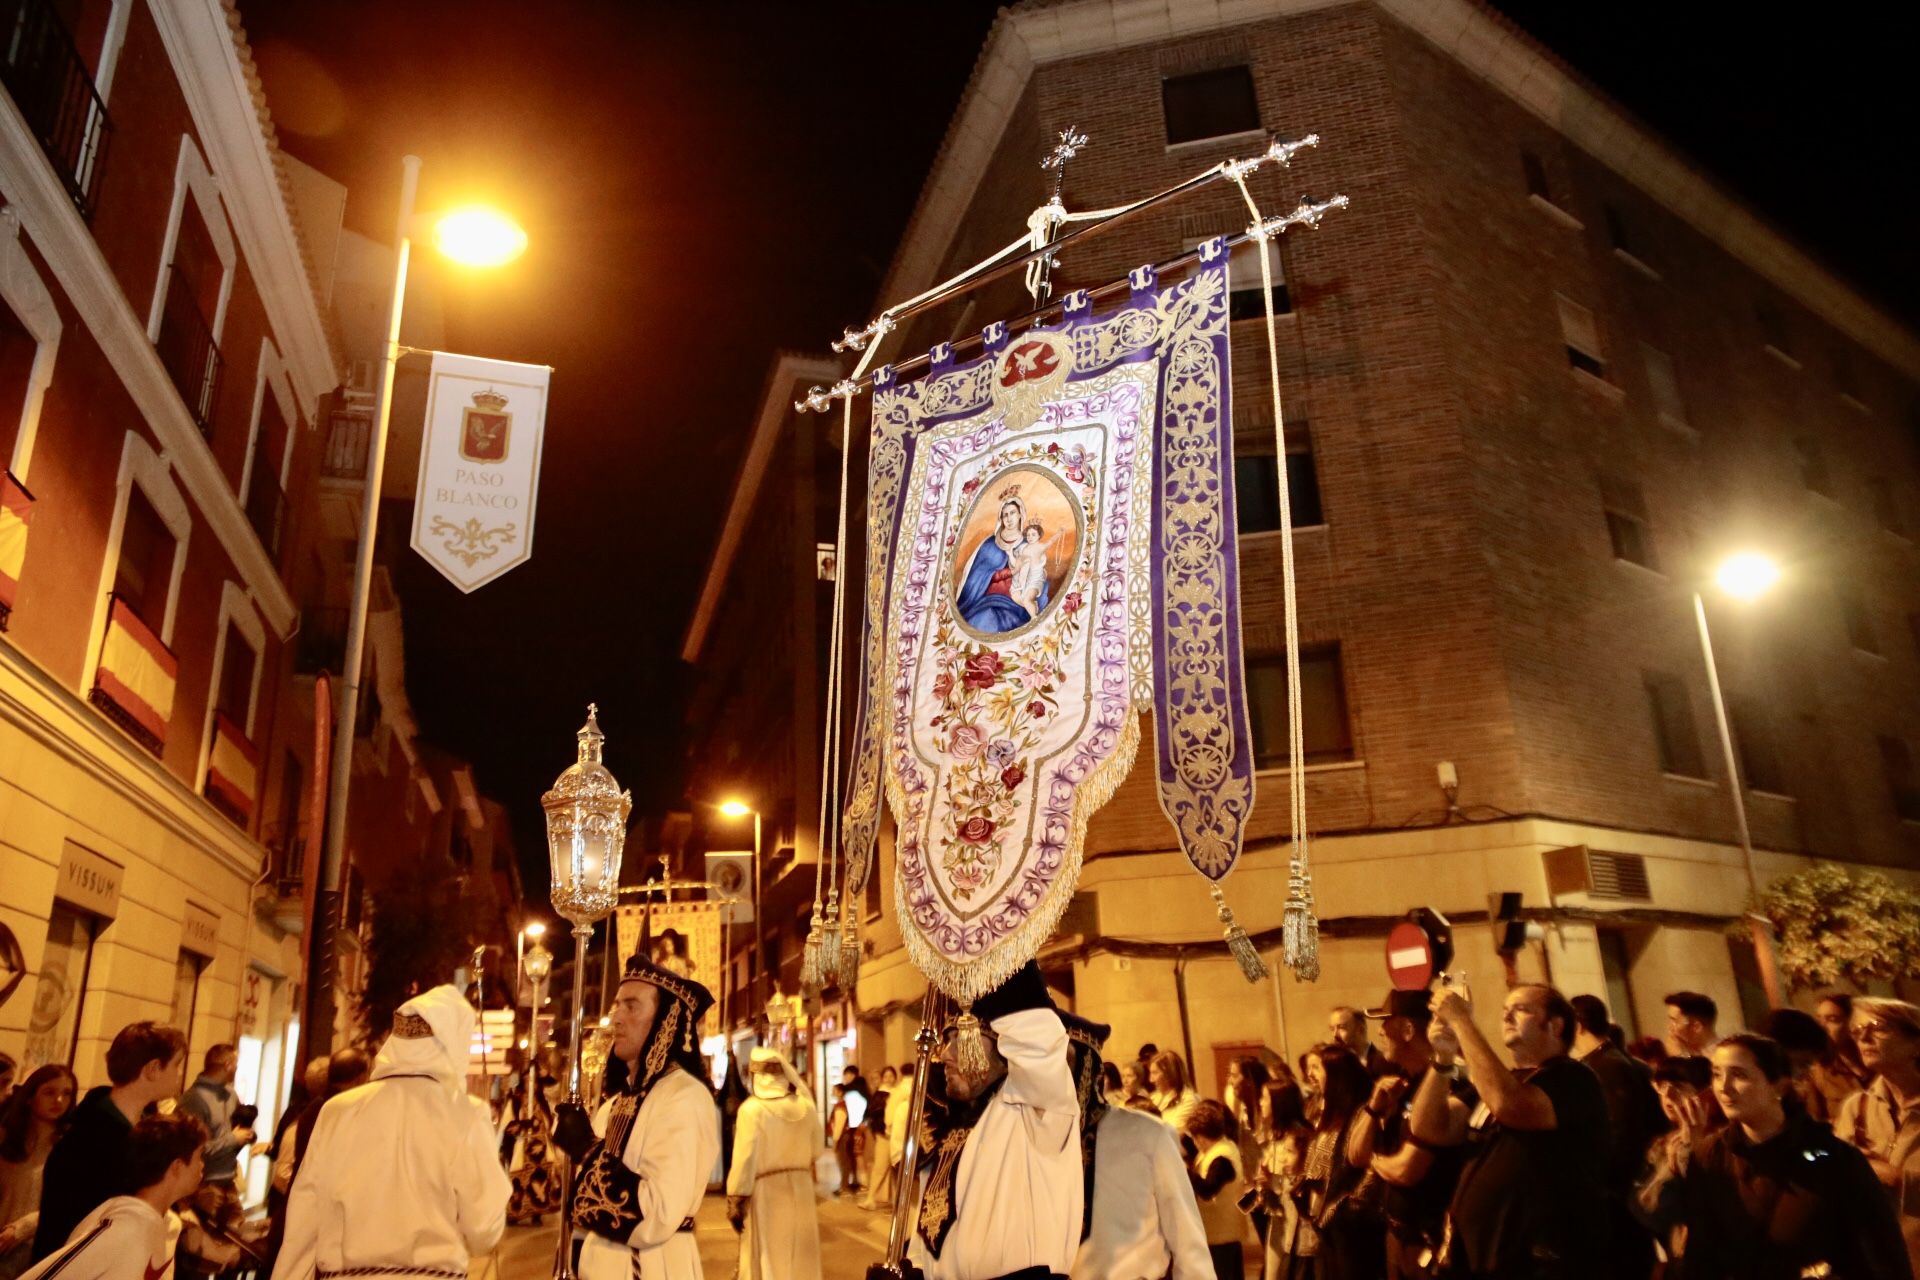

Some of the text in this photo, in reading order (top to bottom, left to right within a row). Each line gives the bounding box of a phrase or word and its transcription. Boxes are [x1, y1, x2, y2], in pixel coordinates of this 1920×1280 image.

[455, 469, 504, 488] PASO
[436, 488, 518, 510] BLANCO
[68, 861, 115, 899] VISSUM
